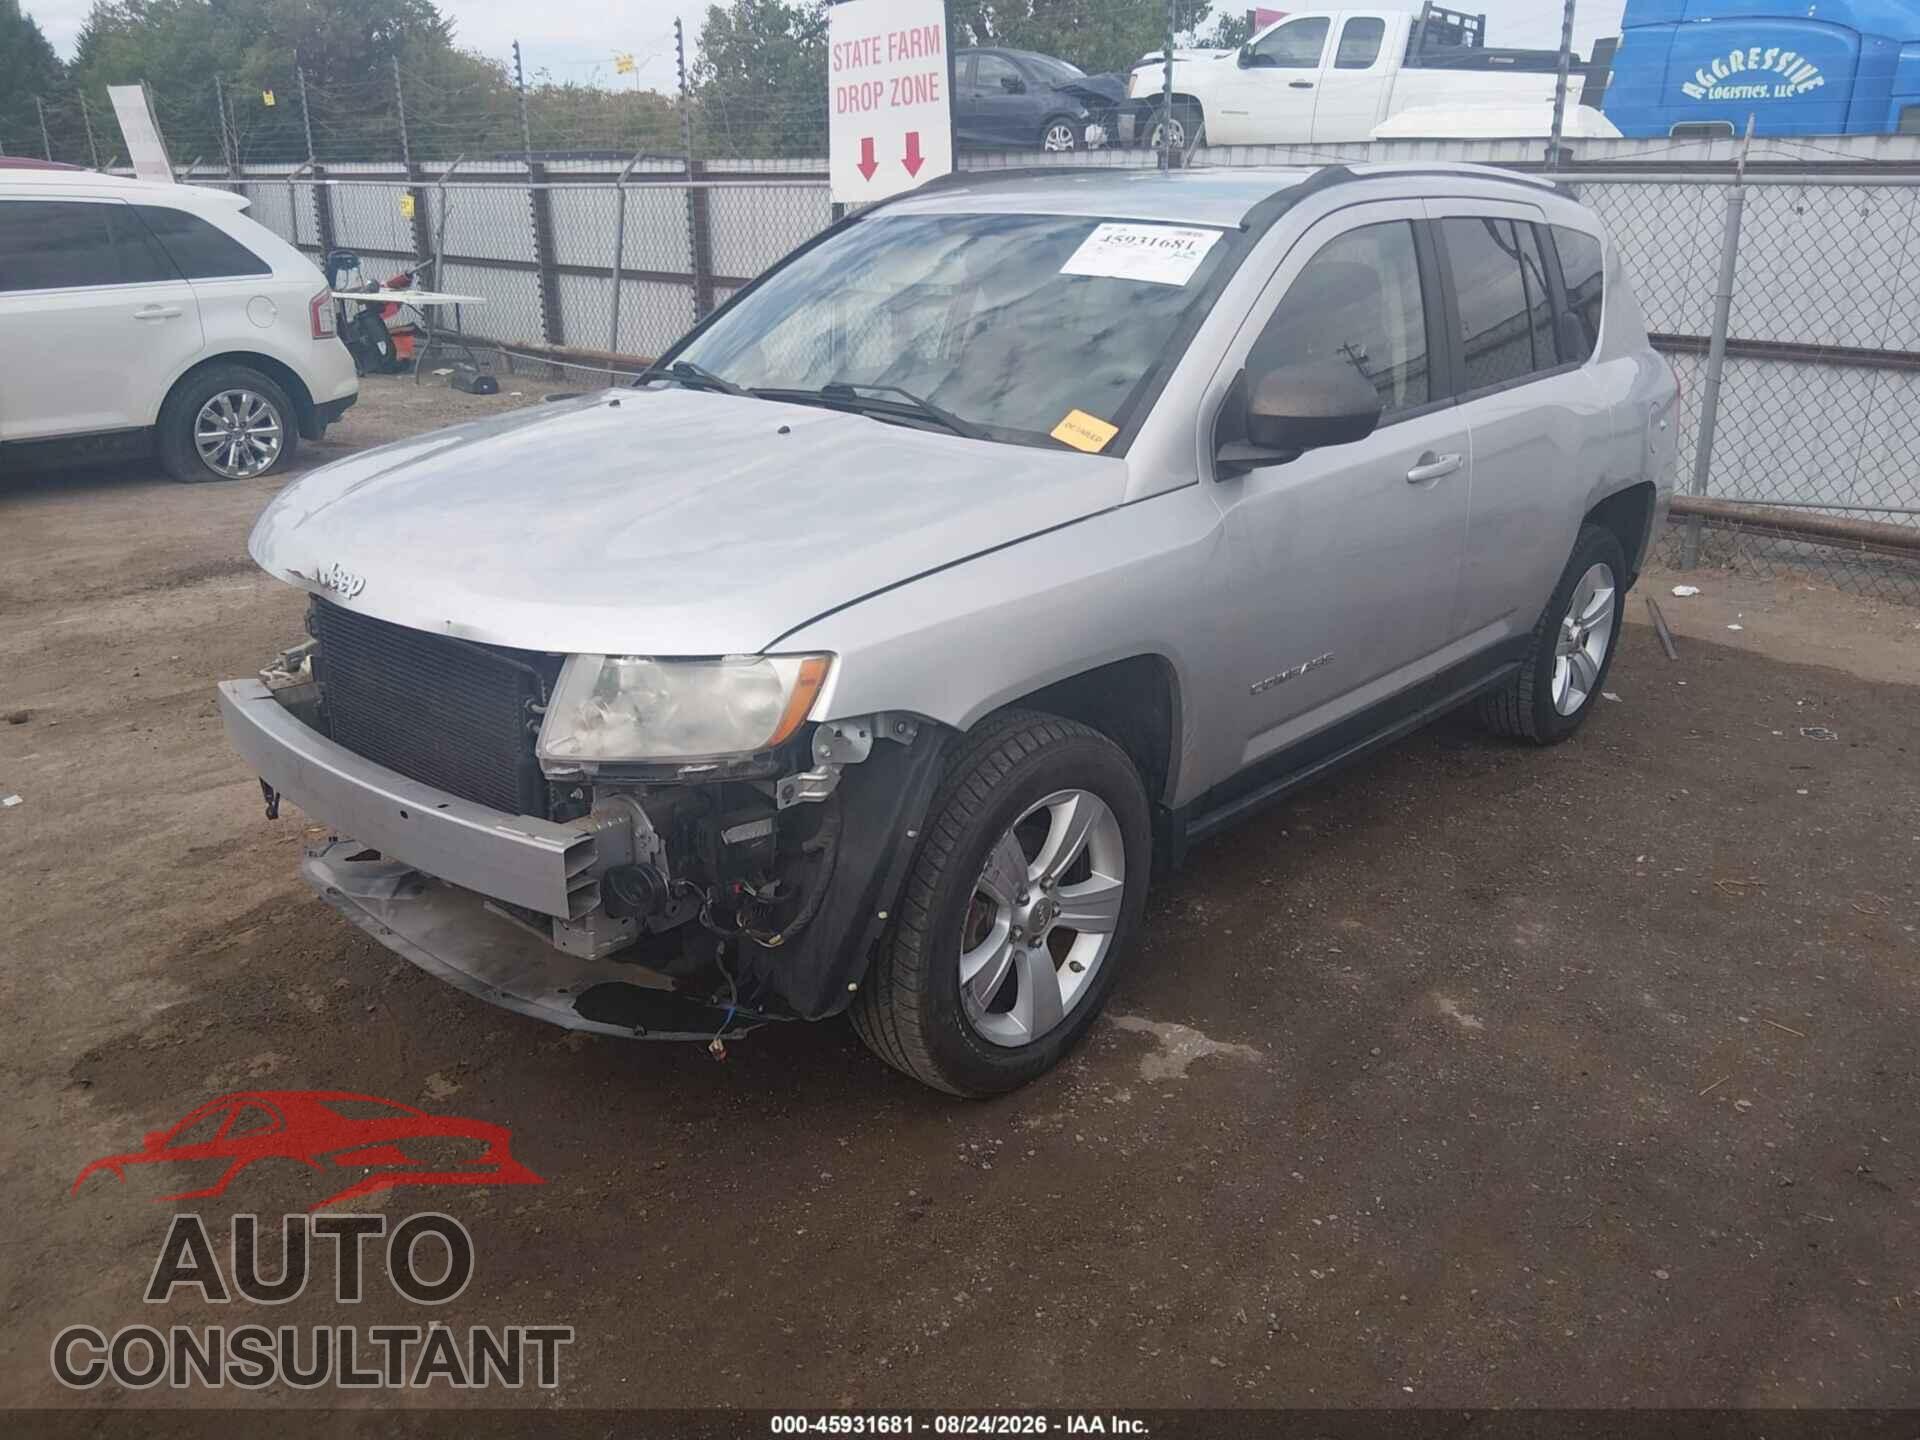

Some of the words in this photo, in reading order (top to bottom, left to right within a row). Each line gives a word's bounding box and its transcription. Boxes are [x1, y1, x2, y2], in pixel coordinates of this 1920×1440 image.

[833, 36, 881, 72] STATE
[888, 24, 941, 62] FARM
[837, 81, 884, 114] DROP
[890, 72, 940, 107] ZONE
[1681, 47, 1825, 100] AGGRESSIVE
[1774, 84, 1795, 98] LLC
[1101, 234, 1195, 250] 45931681
